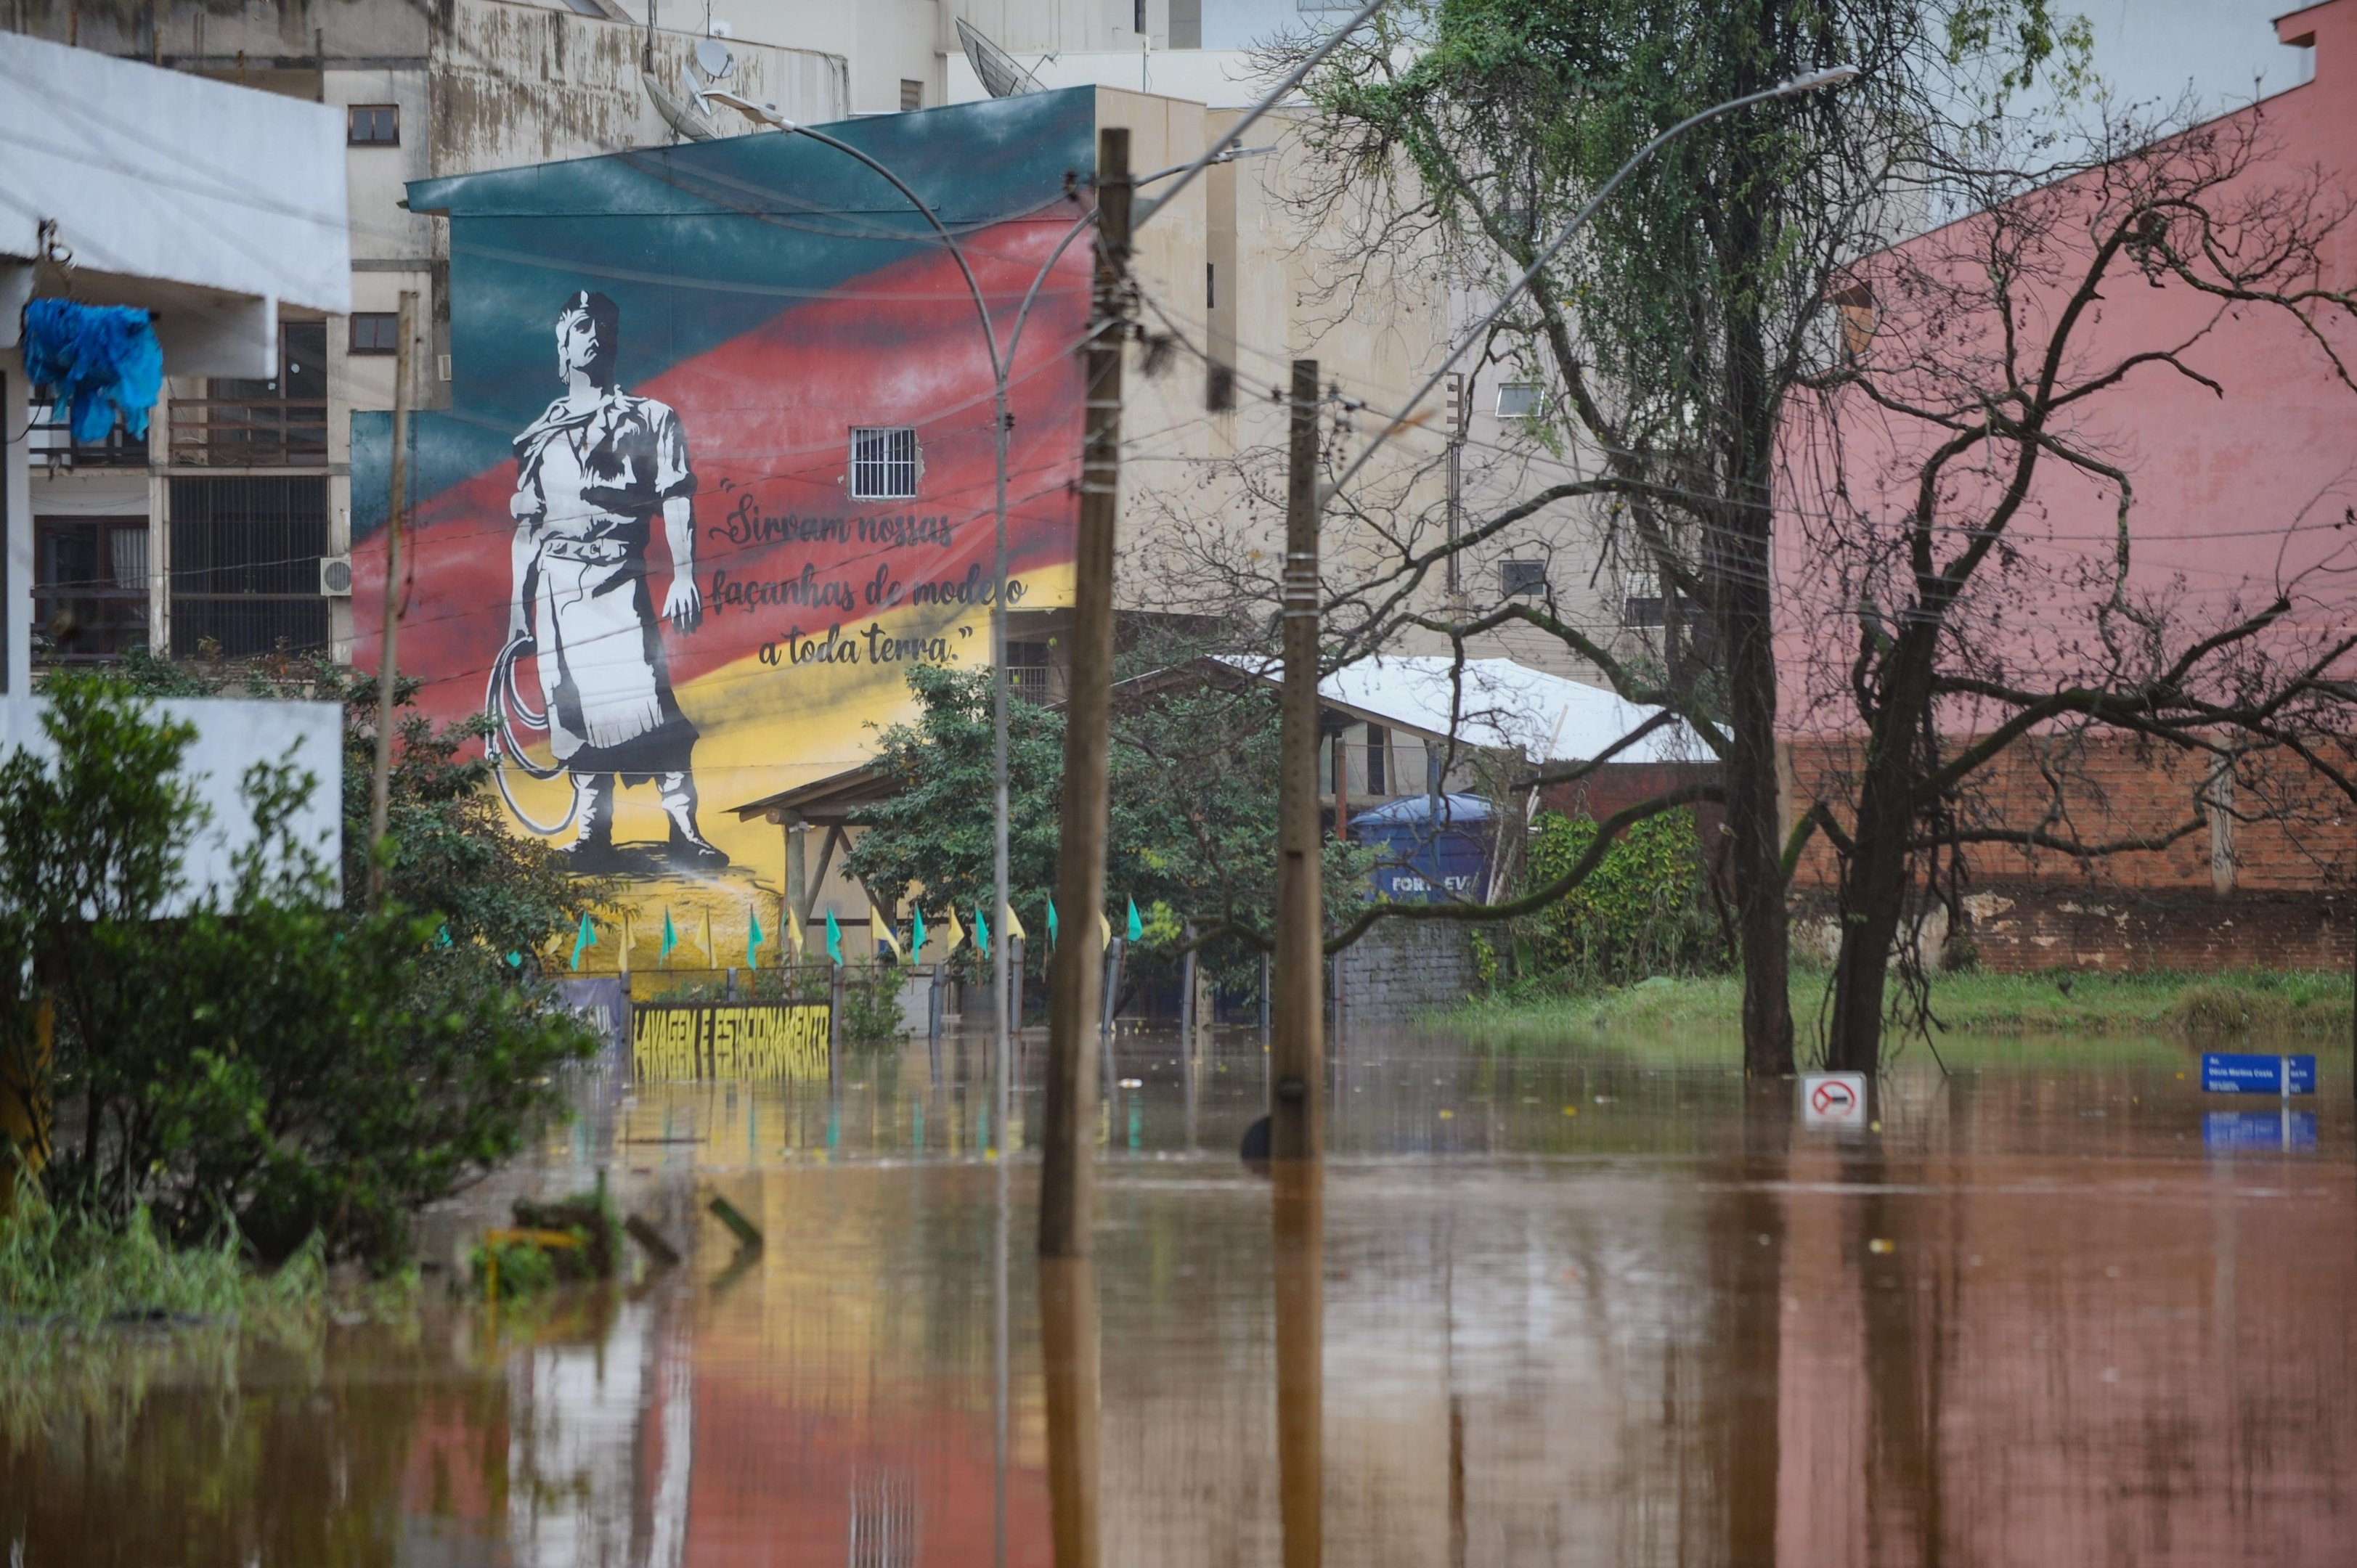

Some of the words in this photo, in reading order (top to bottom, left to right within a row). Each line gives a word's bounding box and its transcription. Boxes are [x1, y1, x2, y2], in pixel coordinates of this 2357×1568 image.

[858, 515, 953, 548] nossas
[704, 563, 858, 615] façanhas
[865, 563, 905, 607] de
[759, 641, 783, 666] a
[781, 623, 862, 665] toda
[632, 1008, 698, 1048] LAVAGEM
[699, 1008, 712, 1048] E
